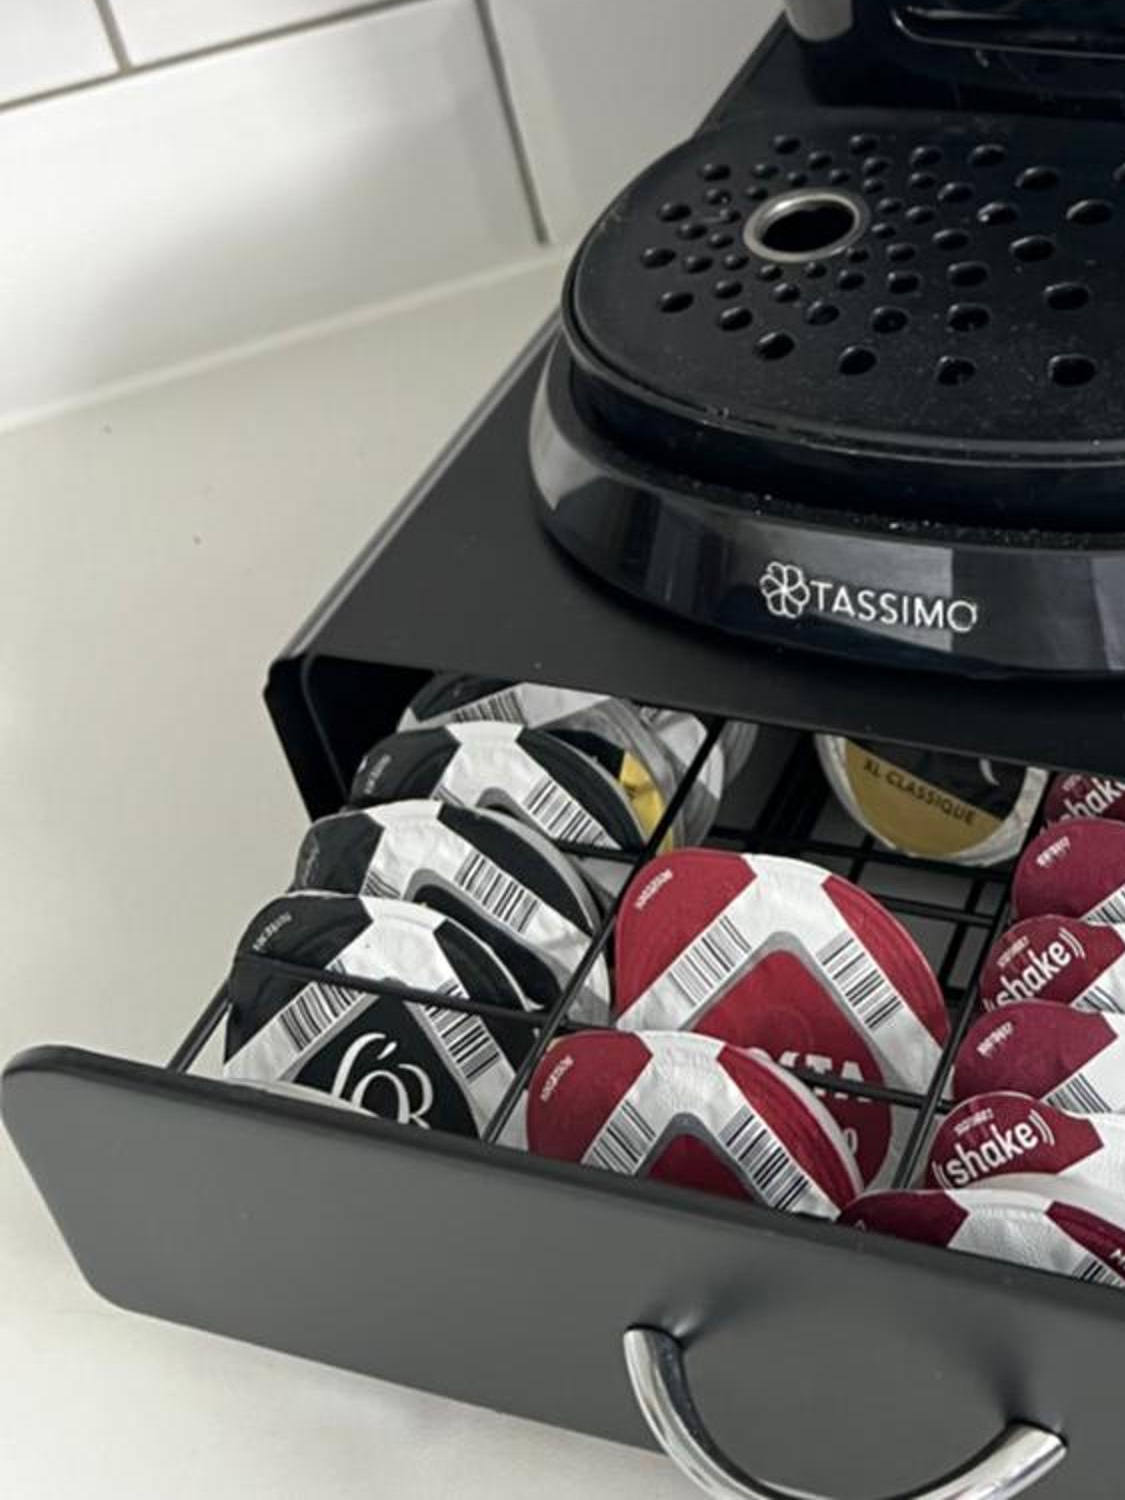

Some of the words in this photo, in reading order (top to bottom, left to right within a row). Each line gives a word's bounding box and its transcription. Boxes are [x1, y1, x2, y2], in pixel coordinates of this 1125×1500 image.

[810, 579, 978, 633] TASSIMO
[863, 758, 882, 779] XL
[886, 770, 976, 827] CLASSIQUE
[995, 941, 1072, 1008] shake
[945, 1118, 1038, 1186] shake
